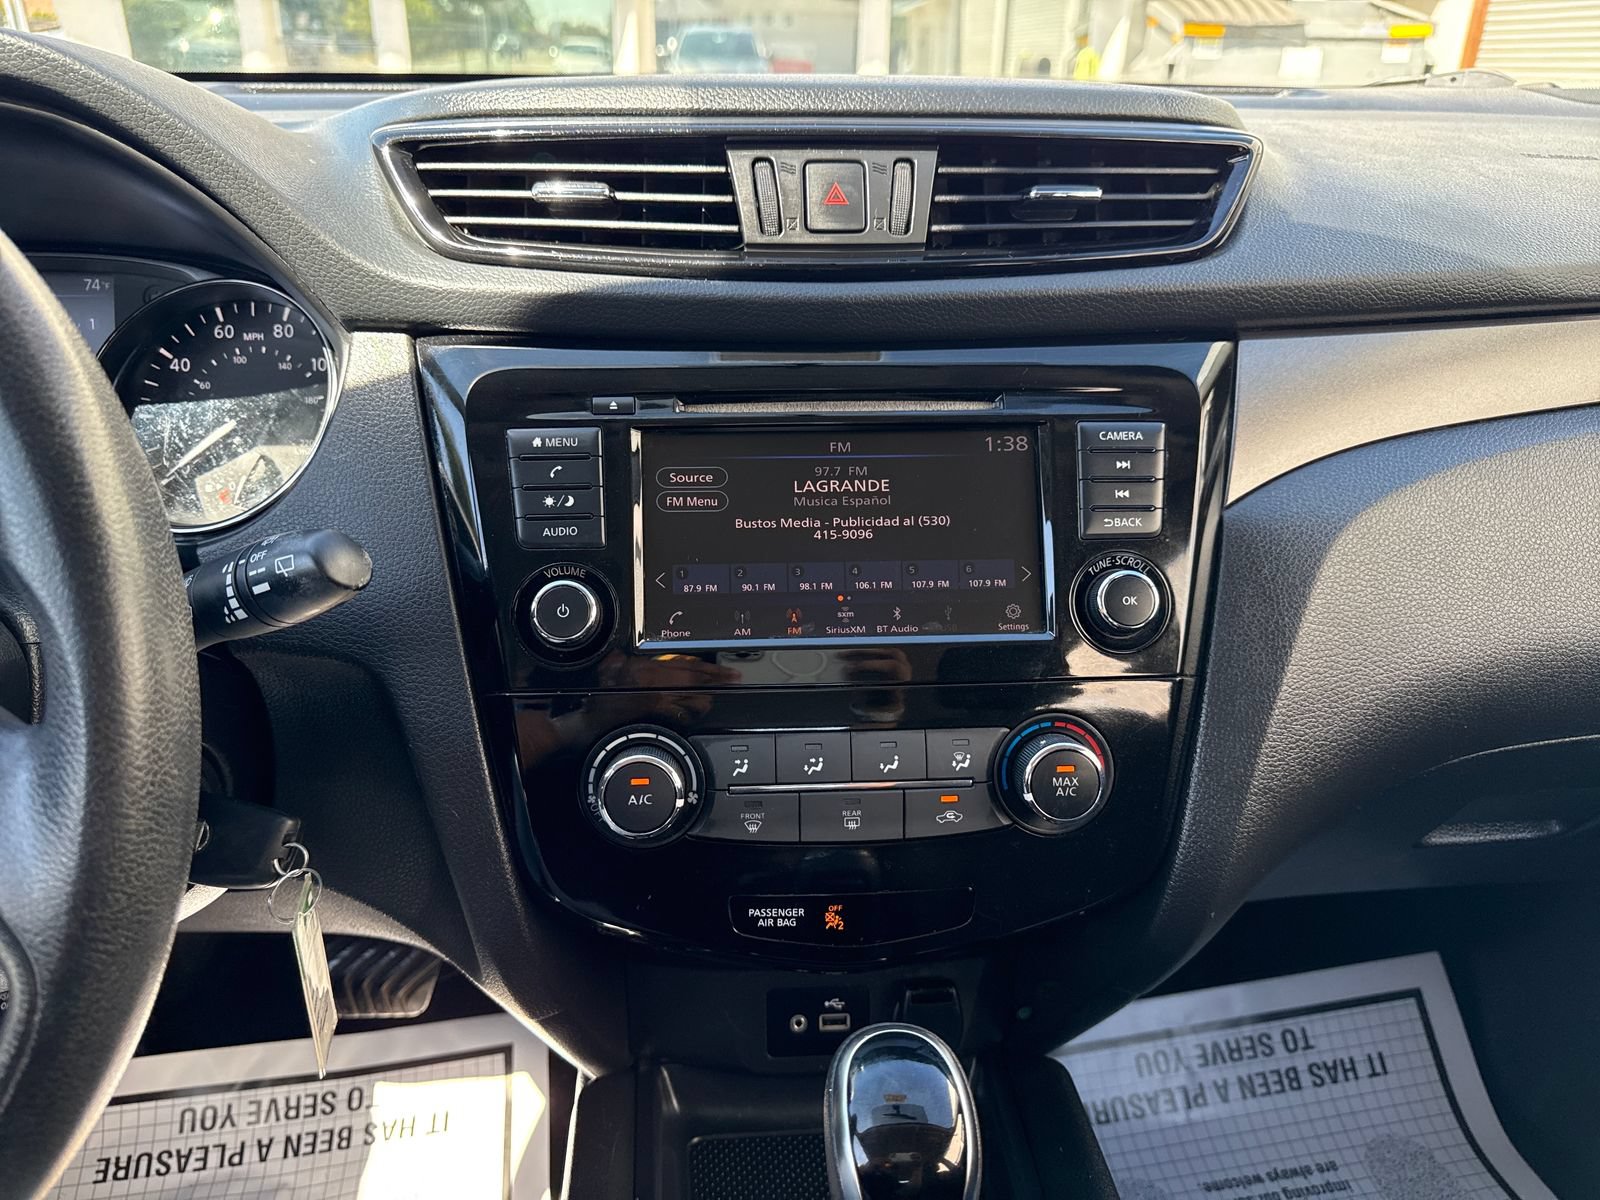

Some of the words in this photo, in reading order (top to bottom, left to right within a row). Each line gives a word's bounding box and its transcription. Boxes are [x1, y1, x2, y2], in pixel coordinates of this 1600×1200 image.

[213, 324, 235, 339] 60
[243, 332, 264, 341] MPH
[272, 323, 294, 339] 80
[169, 357, 191, 372] 40
[232, 356, 248, 364] 100
[277, 362, 292, 370] 140
[199, 381, 211, 390] 60
[1099, 431, 1143, 441] CAMERA
[545, 437, 578, 447] MENU
[829, 441, 851, 453] FM
[985, 435, 1028, 452] 1:38
[814, 466, 841, 477] 97.7
[848, 466, 868, 476] FM
[669, 472, 713, 483] Source
[794, 479, 890, 493] LAGRANDE
[666, 496, 683, 507] FM
[686, 496, 718, 507] Menu
[793, 496, 838, 507] Musica
[842, 495, 891, 508] Español
[735, 518, 777, 529] Bustos
[780, 517, 821, 528] Media
[833, 516, 900, 527] Publicidad
[903, 516, 914, 527] al
[918, 515, 951, 528] (530)
[1114, 517, 1142, 527] BACK
[543, 526, 578, 537] AUDIO
[813, 529, 873, 540] 415-9096
[249, 549, 268, 563] OFF
[543, 566, 587, 578] VOLUME
[679, 569, 684, 578] 1
[737, 569, 744, 577] 2
[795, 568, 801, 576] 3
[852, 567, 858, 575] 4
[909, 566, 915, 574] 5
[965, 565, 972, 573] 6
[683, 584, 702, 592] 87.9
[705, 584, 717, 592] FM
[741, 583, 759, 591] 90.1
[763, 583, 776, 591] FM
[800, 582, 817, 591] 98.1
[820, 582, 833, 590] FM
[854, 581, 876, 589] 106.1
[880, 581, 893, 589] FM
[911, 580, 934, 588] 107.9
[937, 580, 949, 588] FM
[968, 579, 991, 587] 107.9
[994, 579, 1007, 587] FM
[1122, 596, 1138, 606] OK
[733, 628, 751, 636] AM
[787, 627, 802, 635] FM
[825, 625, 866, 634] SiriusXM
[876, 625, 888, 633] BT
[890, 624, 919, 633] Audio
[998, 623, 1029, 632] Settings
[661, 629, 691, 638] Phone
[1052, 776, 1079, 786] MAX
[1055, 786, 1077, 797] A/C
[628, 793, 653, 806] A/C
[740, 812, 765, 820] FRONT
[748, 908, 805, 917] PASSENGER
[828, 904, 843, 912] OFF
[757, 918, 774, 927] AIR
[777, 918, 797, 927] BAG
[1280, 1026, 1315, 1054] TO
[1195, 1031, 1275, 1067] SERVE
[1134, 1047, 1187, 1078] YOU
[1367, 1051, 1389, 1078] IT
[1307, 1056, 1359, 1088] HAS
[1236, 1065, 1302, 1100] BEEN
[1212, 1077, 1231, 1104] A
[246, 1090, 337, 1126] SERVE
[178, 1102, 237, 1134] YOU
[364, 1114, 416, 1146] HAS
[282, 1126, 354, 1159] BEEN
[257, 1136, 274, 1163] A
[92, 1140, 246, 1185] PLEASURE
[1314, 1159, 1339, 1174] are
[1265, 1163, 1315, 1182] always
